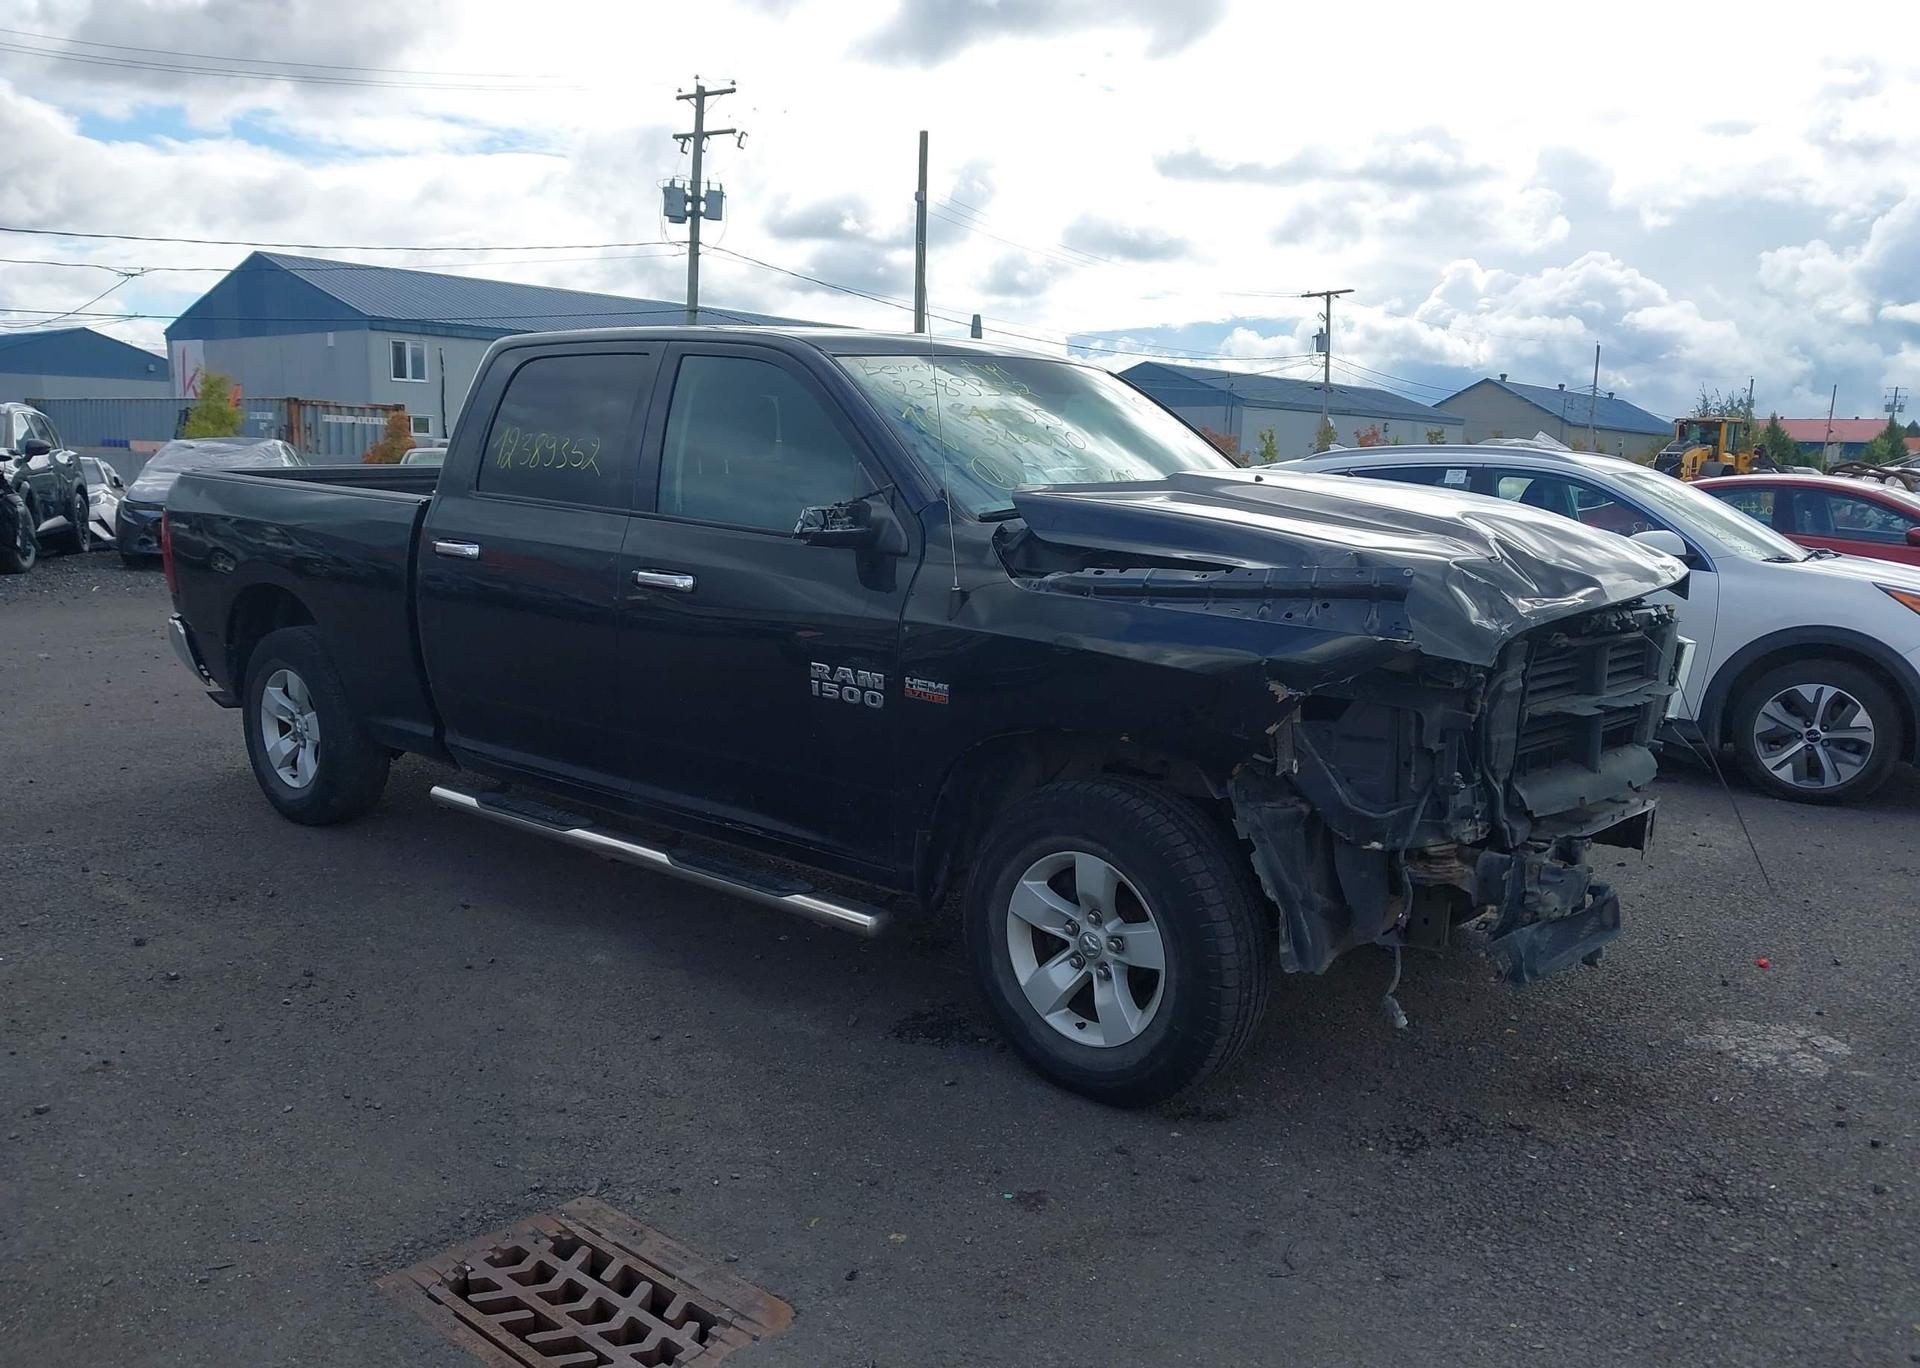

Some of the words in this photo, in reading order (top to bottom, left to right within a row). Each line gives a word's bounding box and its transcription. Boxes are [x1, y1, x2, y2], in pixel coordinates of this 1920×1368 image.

[810, 661, 885, 690] RAM
[904, 676, 950, 695] HEMI
[810, 680, 885, 709] 1500
